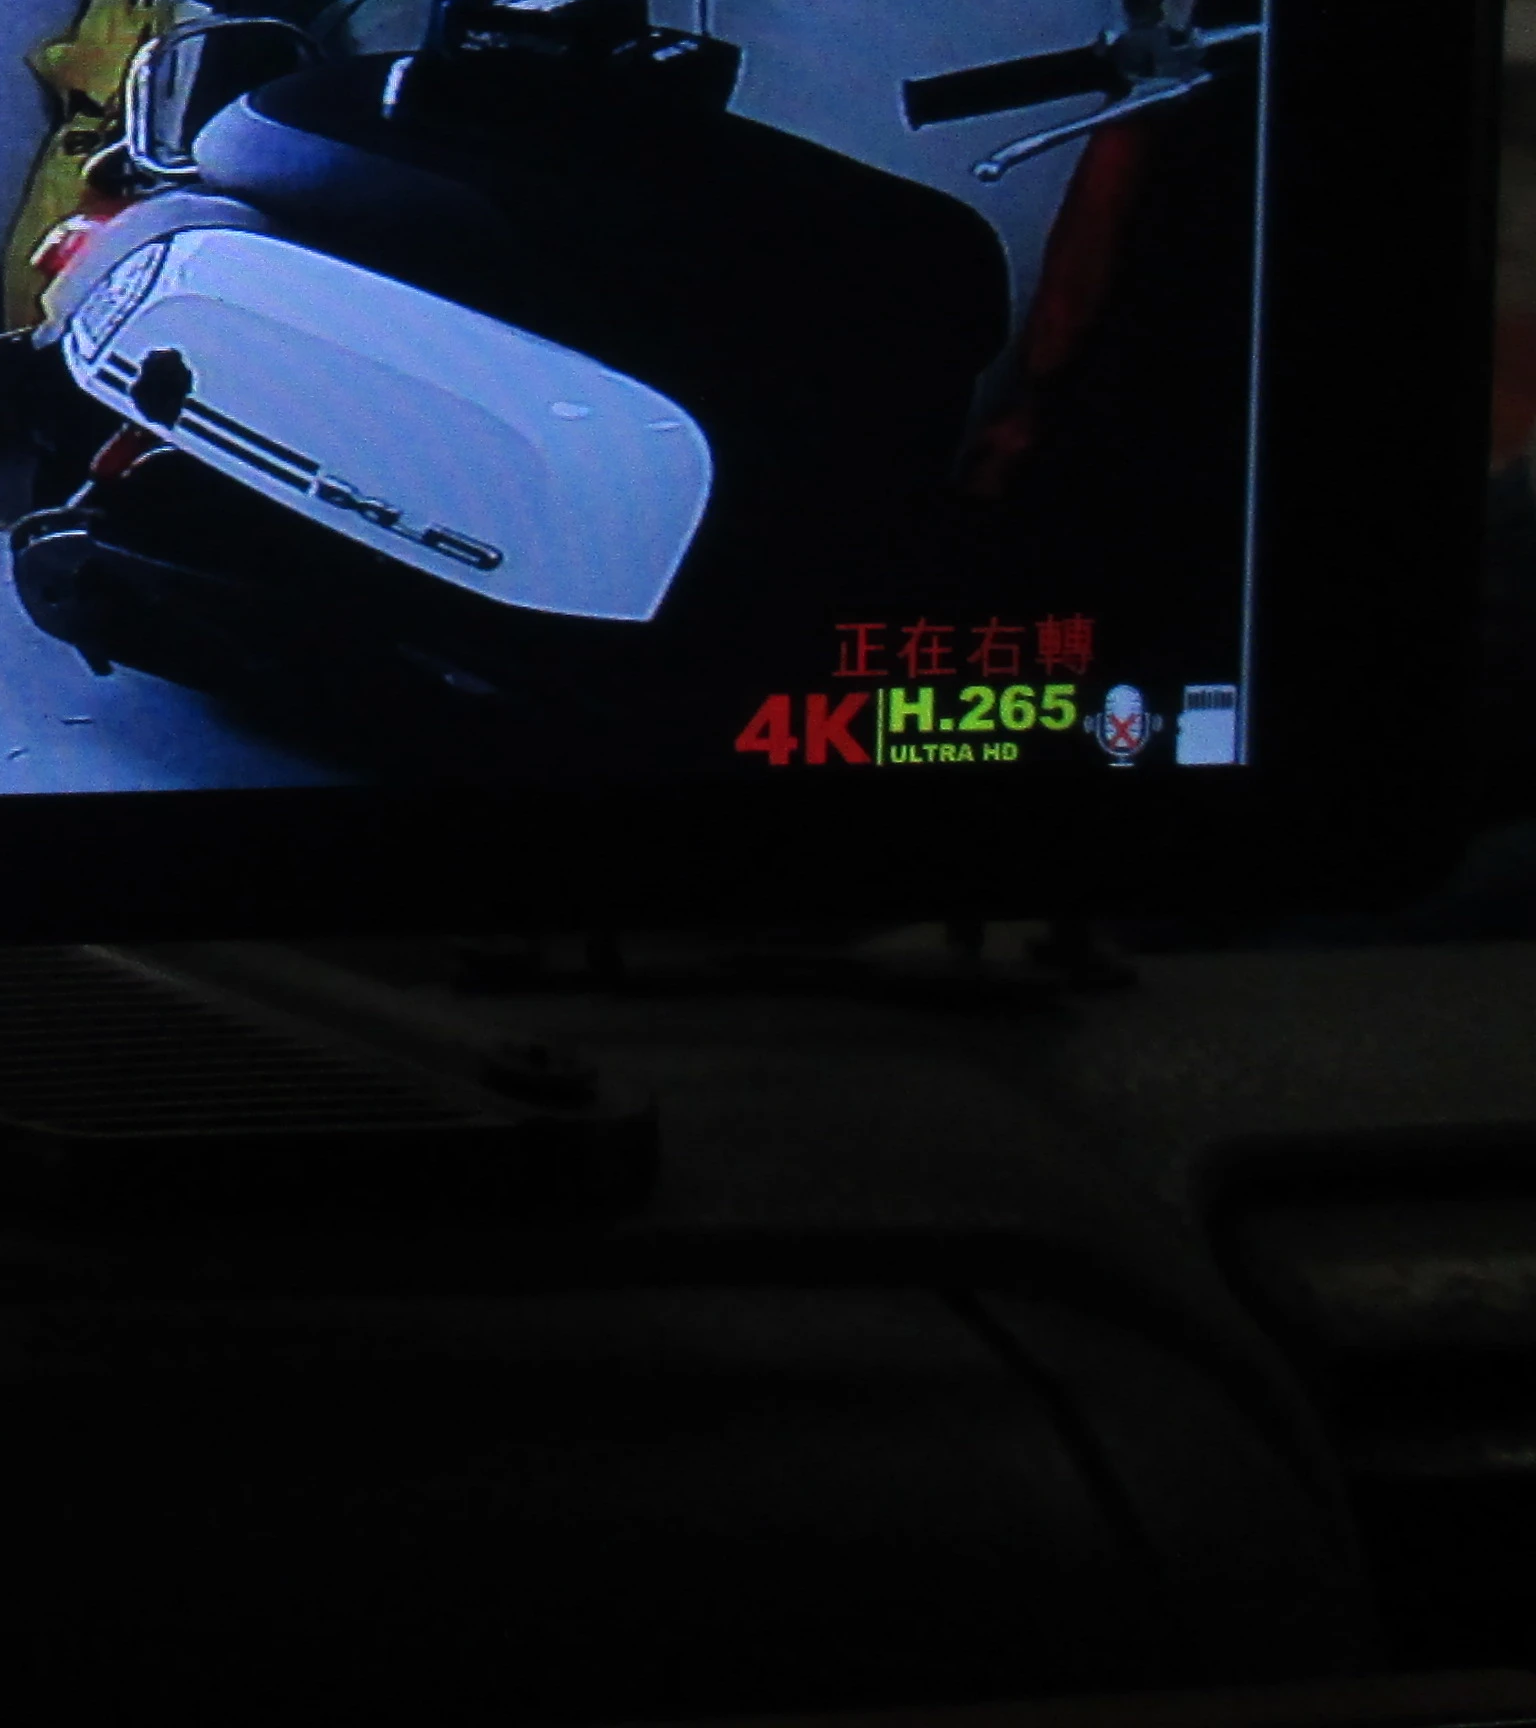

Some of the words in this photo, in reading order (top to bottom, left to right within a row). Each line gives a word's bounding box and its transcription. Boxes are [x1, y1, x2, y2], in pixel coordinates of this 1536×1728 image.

[832, 613, 1095, 679] 正在右轉
[734, 693, 872, 766] 4K
[888, 683, 1078, 734] H.265
[889, 742, 975, 763] ULTRA
[981, 742, 1020, 763] HD
